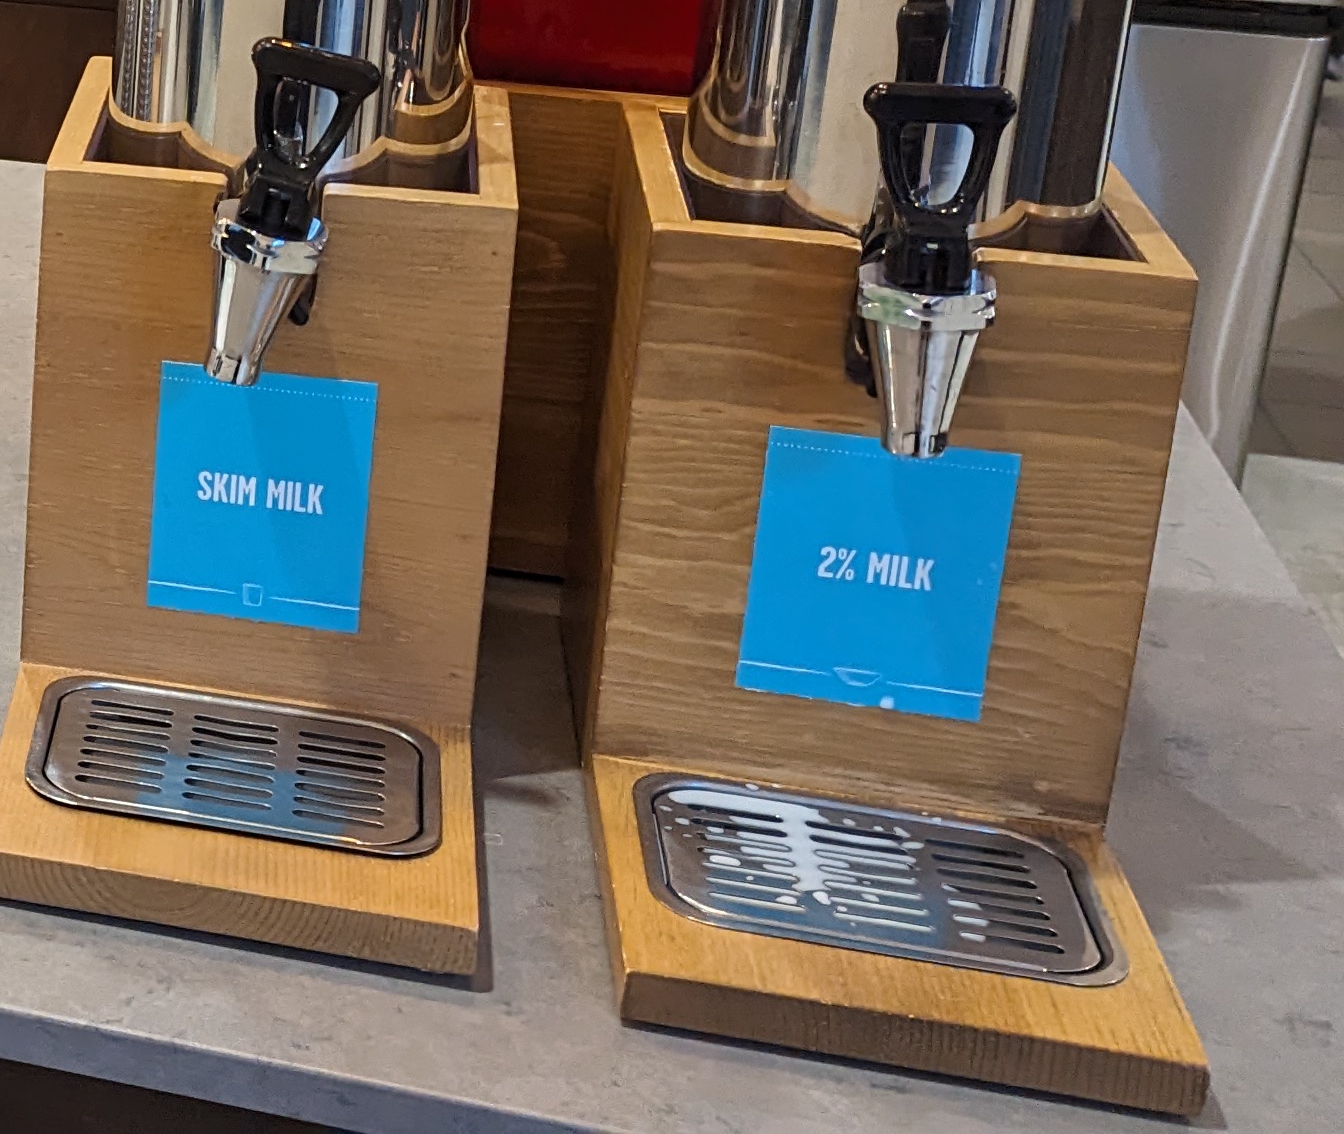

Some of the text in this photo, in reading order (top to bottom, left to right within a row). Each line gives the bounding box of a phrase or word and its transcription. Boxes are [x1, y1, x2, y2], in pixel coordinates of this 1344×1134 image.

[197, 470, 324, 515] SKIM MILK
[817, 546, 935, 591] 2% MILK
